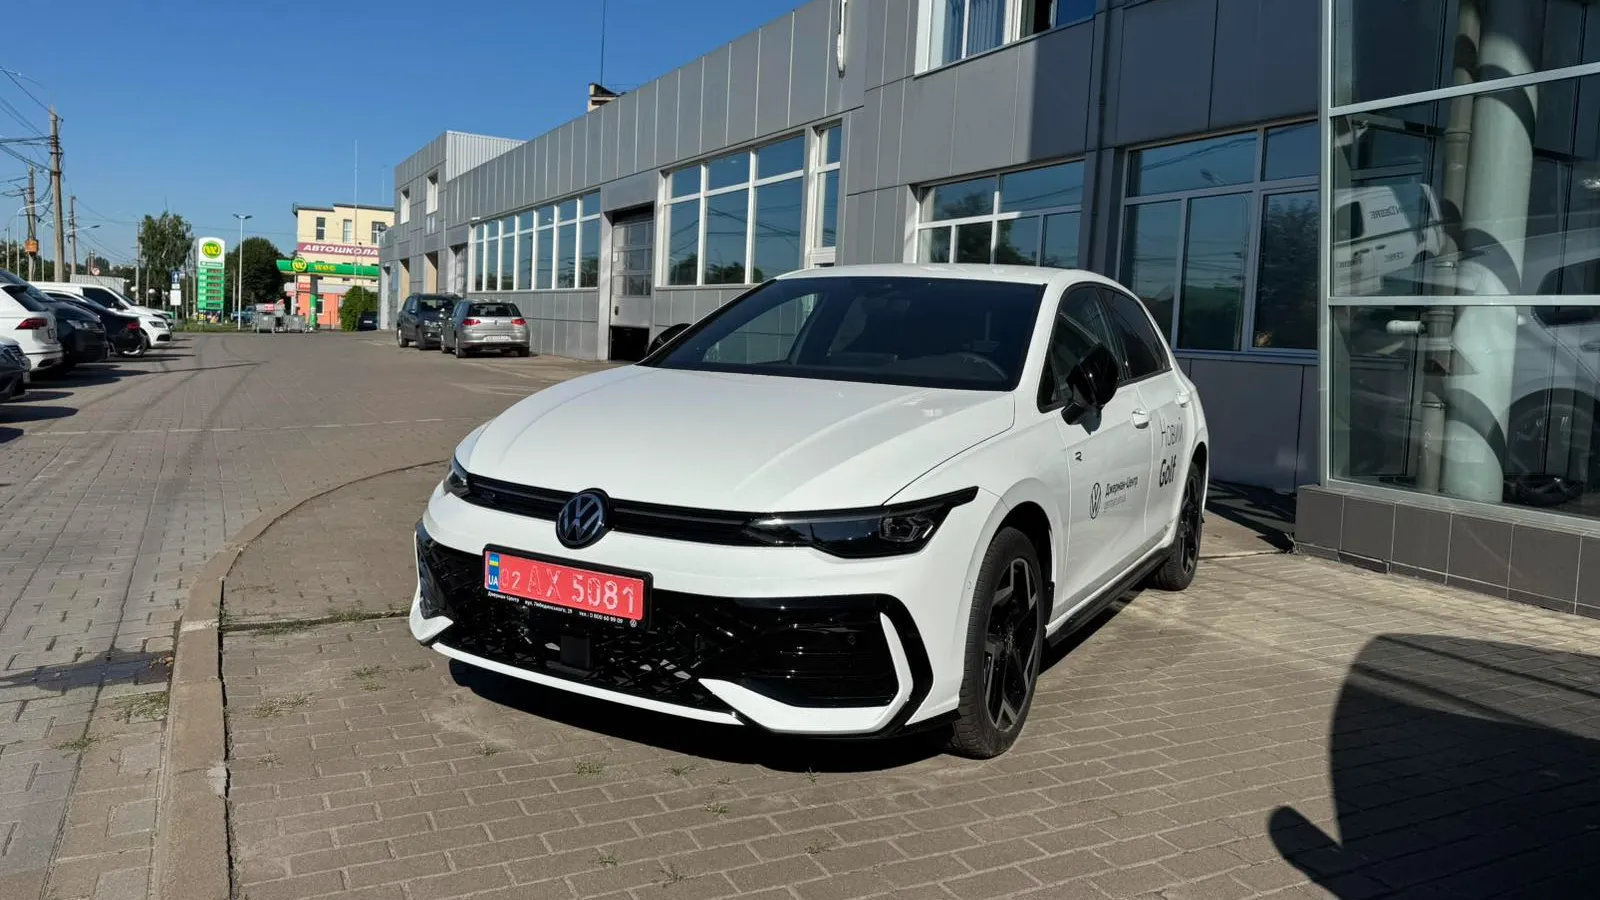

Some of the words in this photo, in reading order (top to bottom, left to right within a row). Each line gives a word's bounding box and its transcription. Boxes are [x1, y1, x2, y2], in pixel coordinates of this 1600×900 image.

[302, 244, 379, 256] АВТОШКОЛА
[1159, 454, 1177, 488] Golf
[488, 574, 499, 586] UA
[500, 567, 521, 590] 02
[527, 565, 561, 600] AX
[571, 574, 635, 614] 5081
